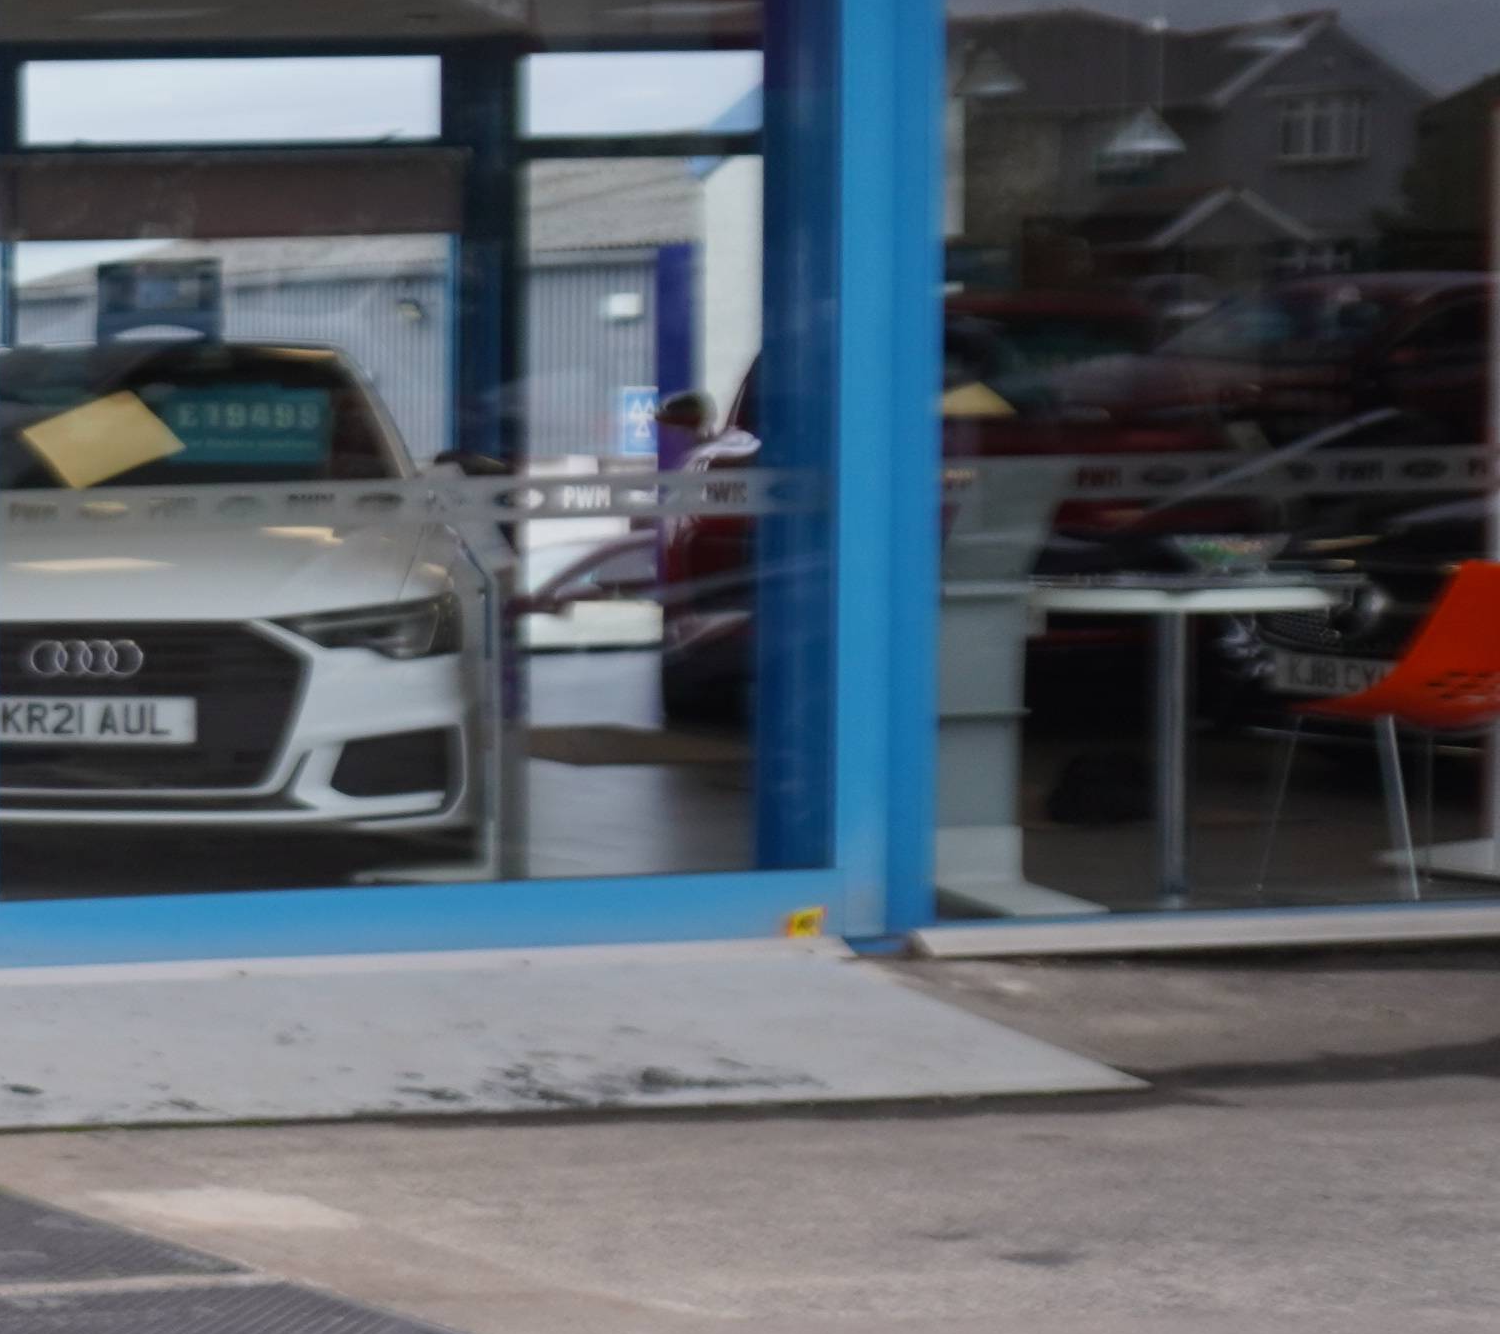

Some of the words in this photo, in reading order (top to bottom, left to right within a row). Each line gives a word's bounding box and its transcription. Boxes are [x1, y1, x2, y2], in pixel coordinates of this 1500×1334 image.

[561, 484, 613, 510] PWM
[1, 702, 85, 735] KR21
[98, 702, 172, 735] AUL
